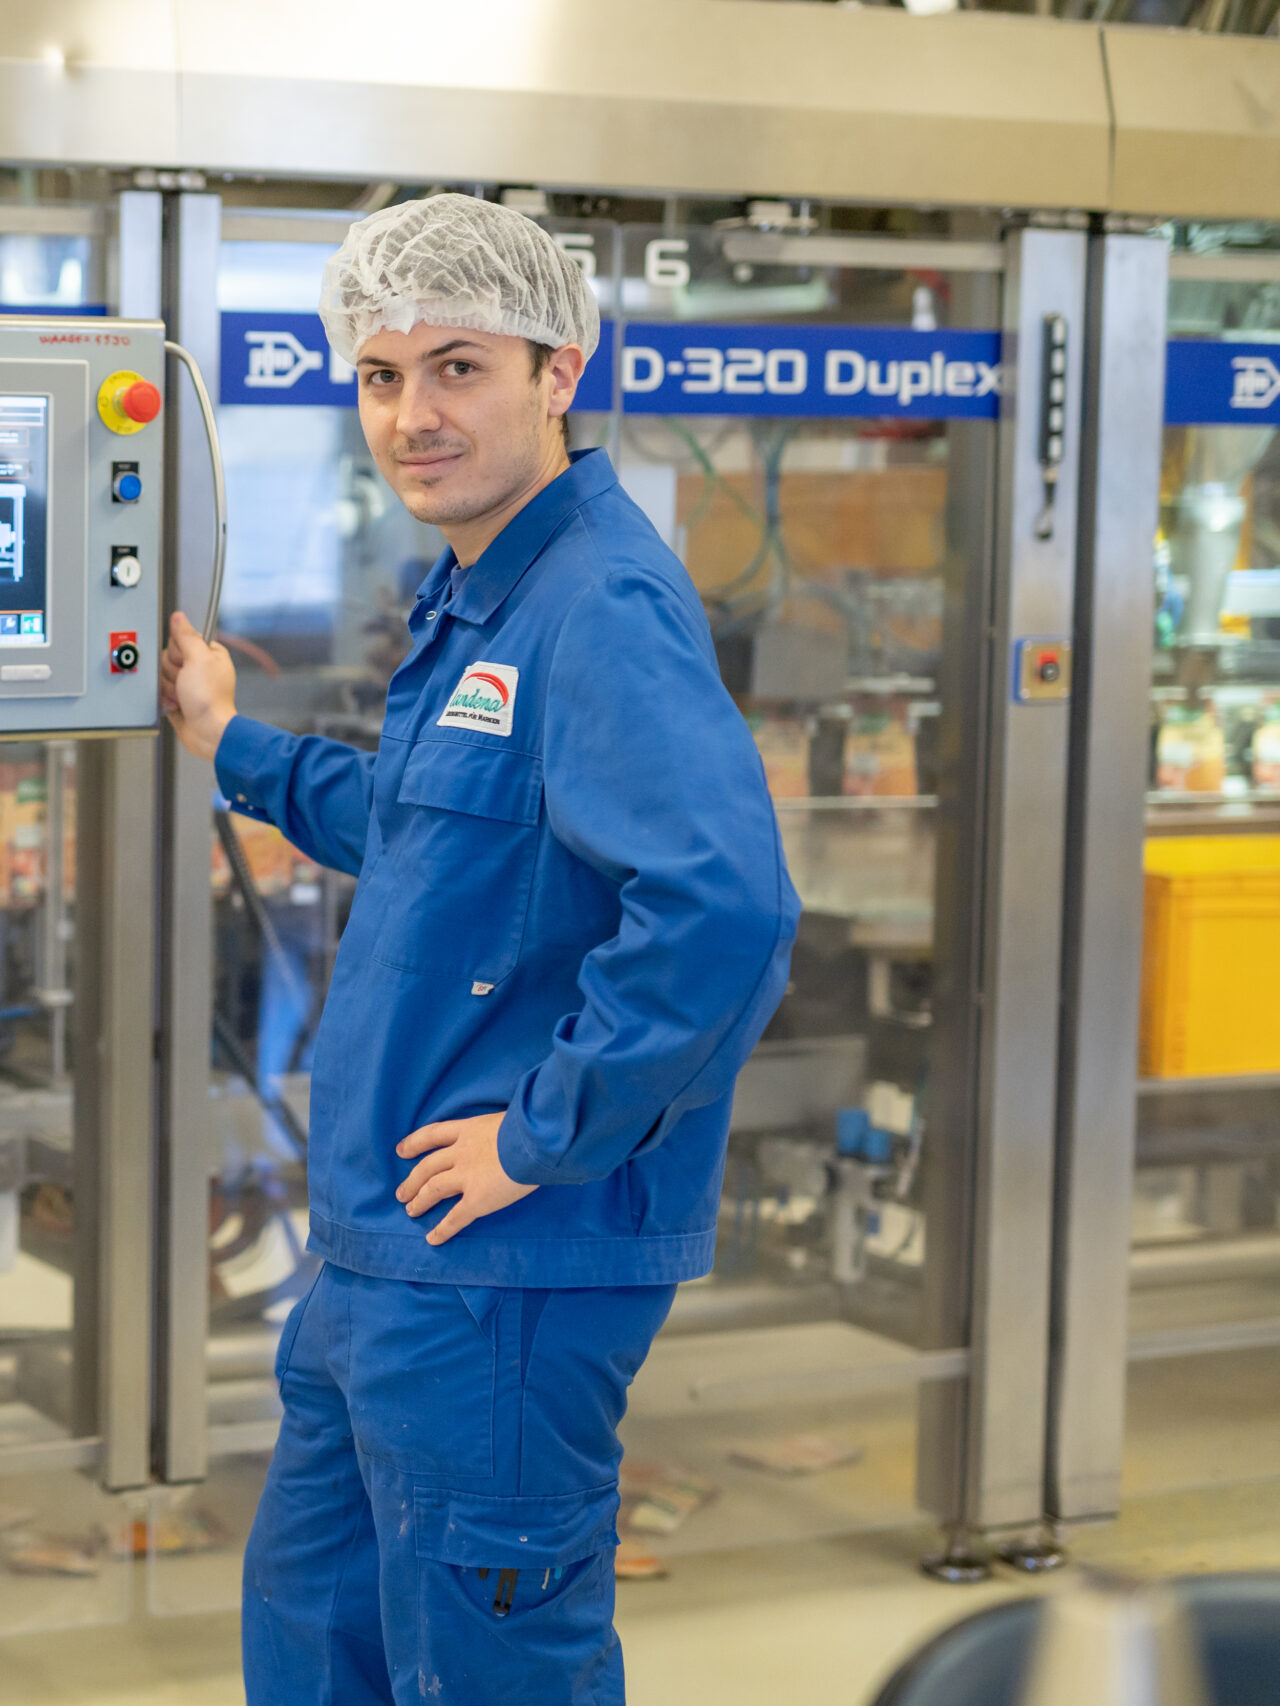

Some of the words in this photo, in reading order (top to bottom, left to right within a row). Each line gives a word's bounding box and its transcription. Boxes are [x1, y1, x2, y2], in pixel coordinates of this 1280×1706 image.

[646, 239, 691, 286] 6
[621, 346, 808, 394] D-320
[824, 349, 1004, 407] Duplex
